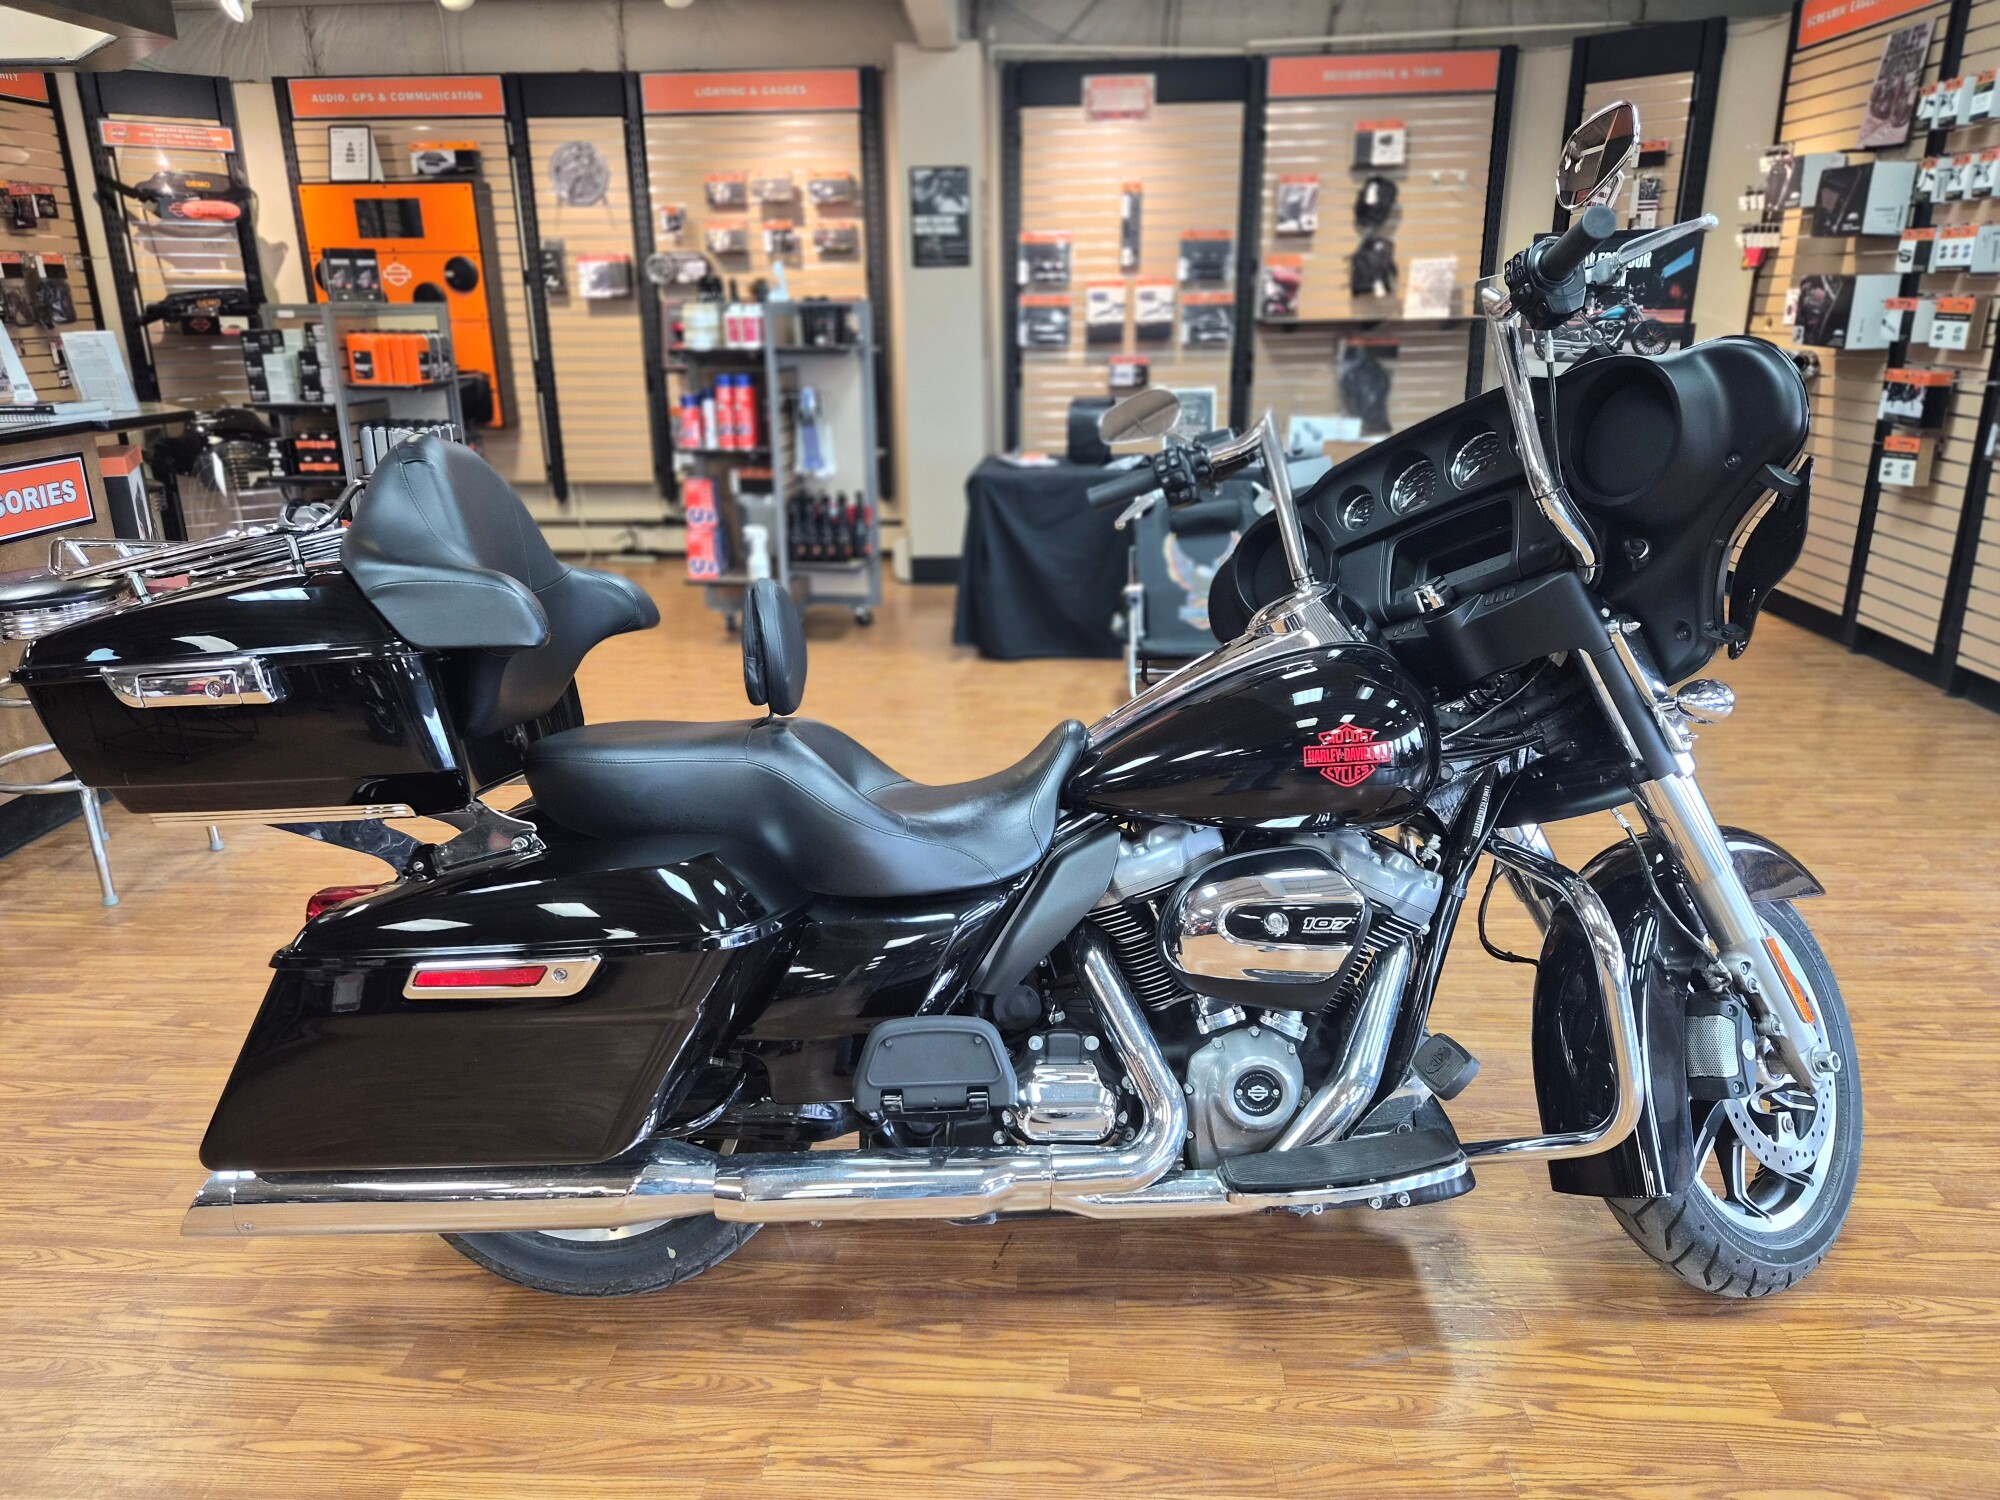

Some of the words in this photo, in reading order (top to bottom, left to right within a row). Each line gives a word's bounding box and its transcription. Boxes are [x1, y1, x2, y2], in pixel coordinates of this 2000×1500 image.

[312, 93, 349, 103] AUDIO,
[352, 93, 374, 102] GPS
[378, 93, 386, 102] &
[390, 91, 483, 101] COMMUNICATION
[694, 86, 746, 97] LIGHTING
[749, 87, 758, 97] &
[761, 85, 807, 96] GAUGES
[185, 180, 211, 188] DEMO
[1327, 765, 1369, 783] CYCLES
[1303, 917, 1352, 930] 107
